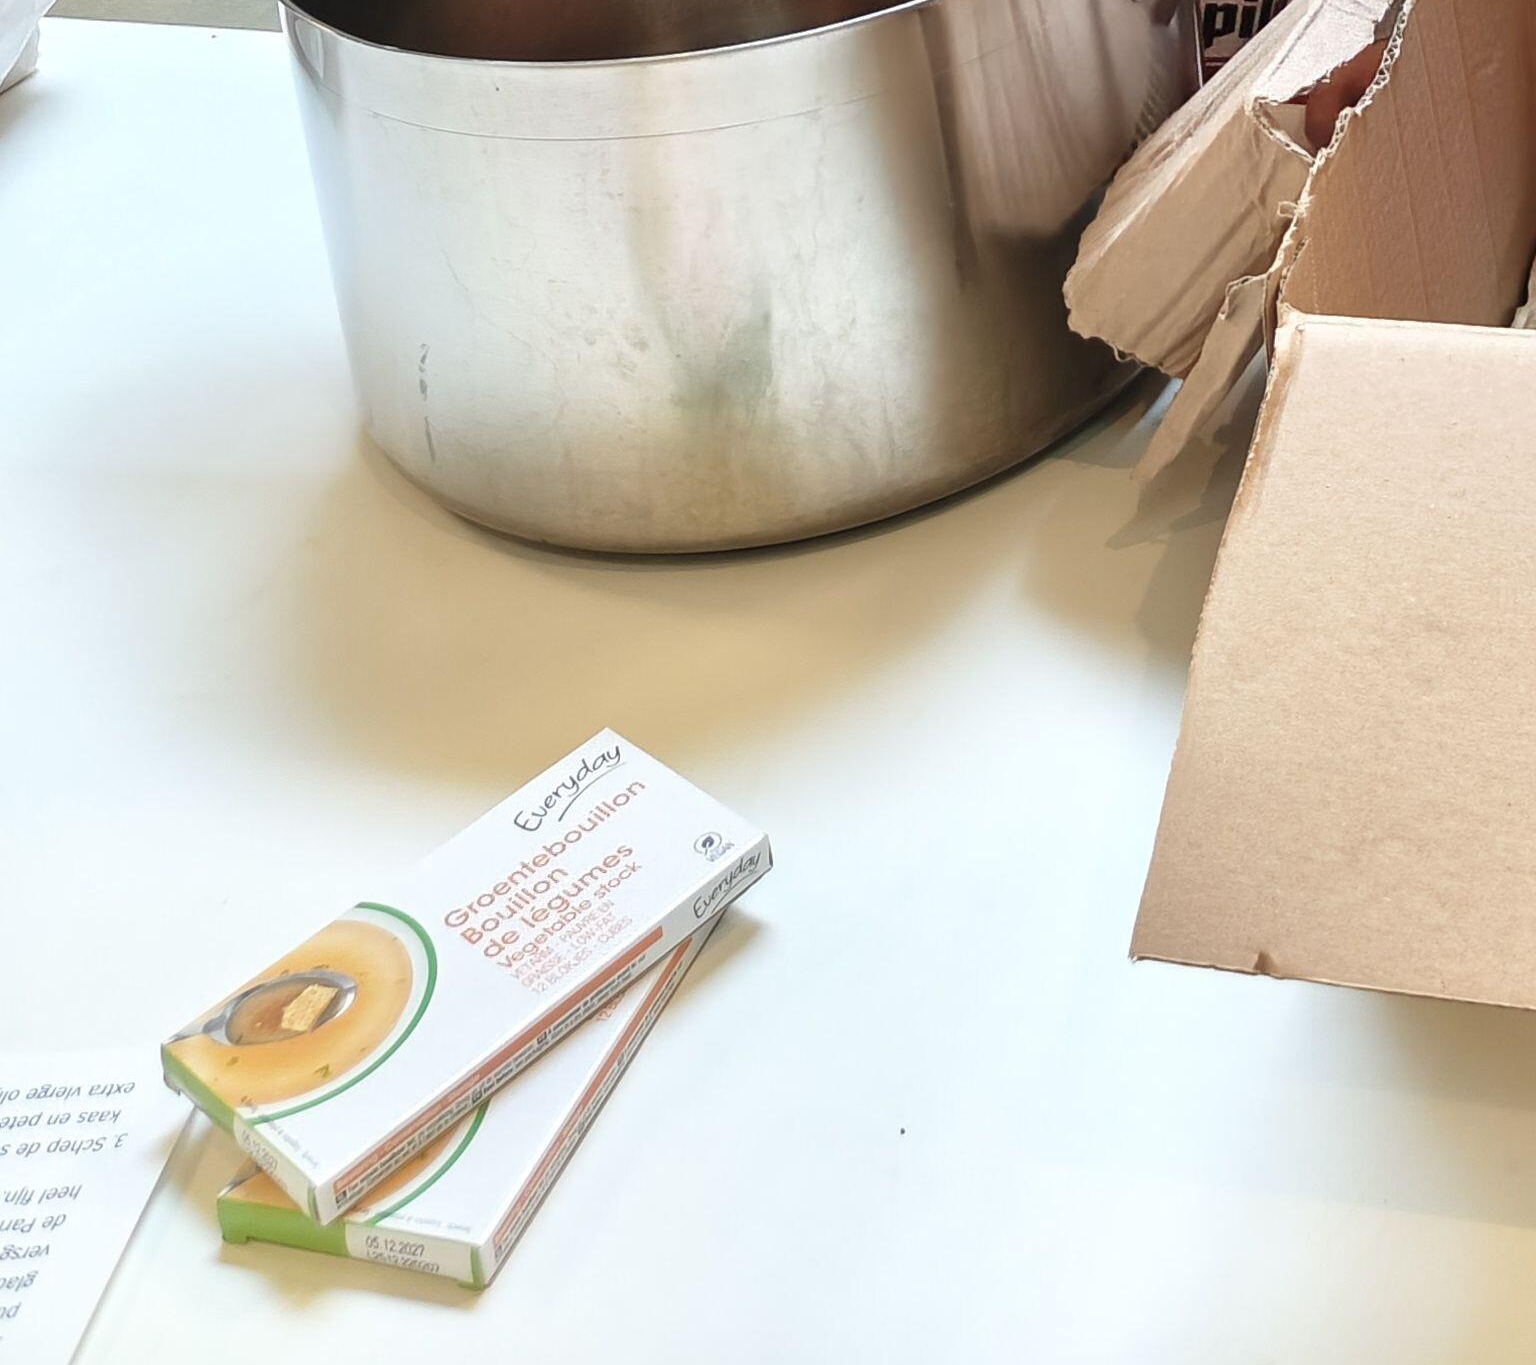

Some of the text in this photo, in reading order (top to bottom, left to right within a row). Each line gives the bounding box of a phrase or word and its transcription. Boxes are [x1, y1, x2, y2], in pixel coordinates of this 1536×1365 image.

[513, 745, 622, 832] Everyday
[444, 779, 647, 928] Groentebouillon
[693, 852, 762, 919] Everyday
[460, 866, 569, 945] Bouillon
[483, 843, 635, 959] de légumes
[497, 861, 642, 968] Vegetable stock
[25, 1083, 82, 1101] vierge
[88, 1082, 136, 1097] extra
[46, 1112, 71, 1126] en
[76, 1110, 122, 1124] kaas
[15, 1141, 41, 1158] de
[46, 1136, 107, 1156] Schep
[113, 1132, 129, 1149] 3.
[38, 1184, 83, 1205] heel
[42, 1214, 67, 1231] de
